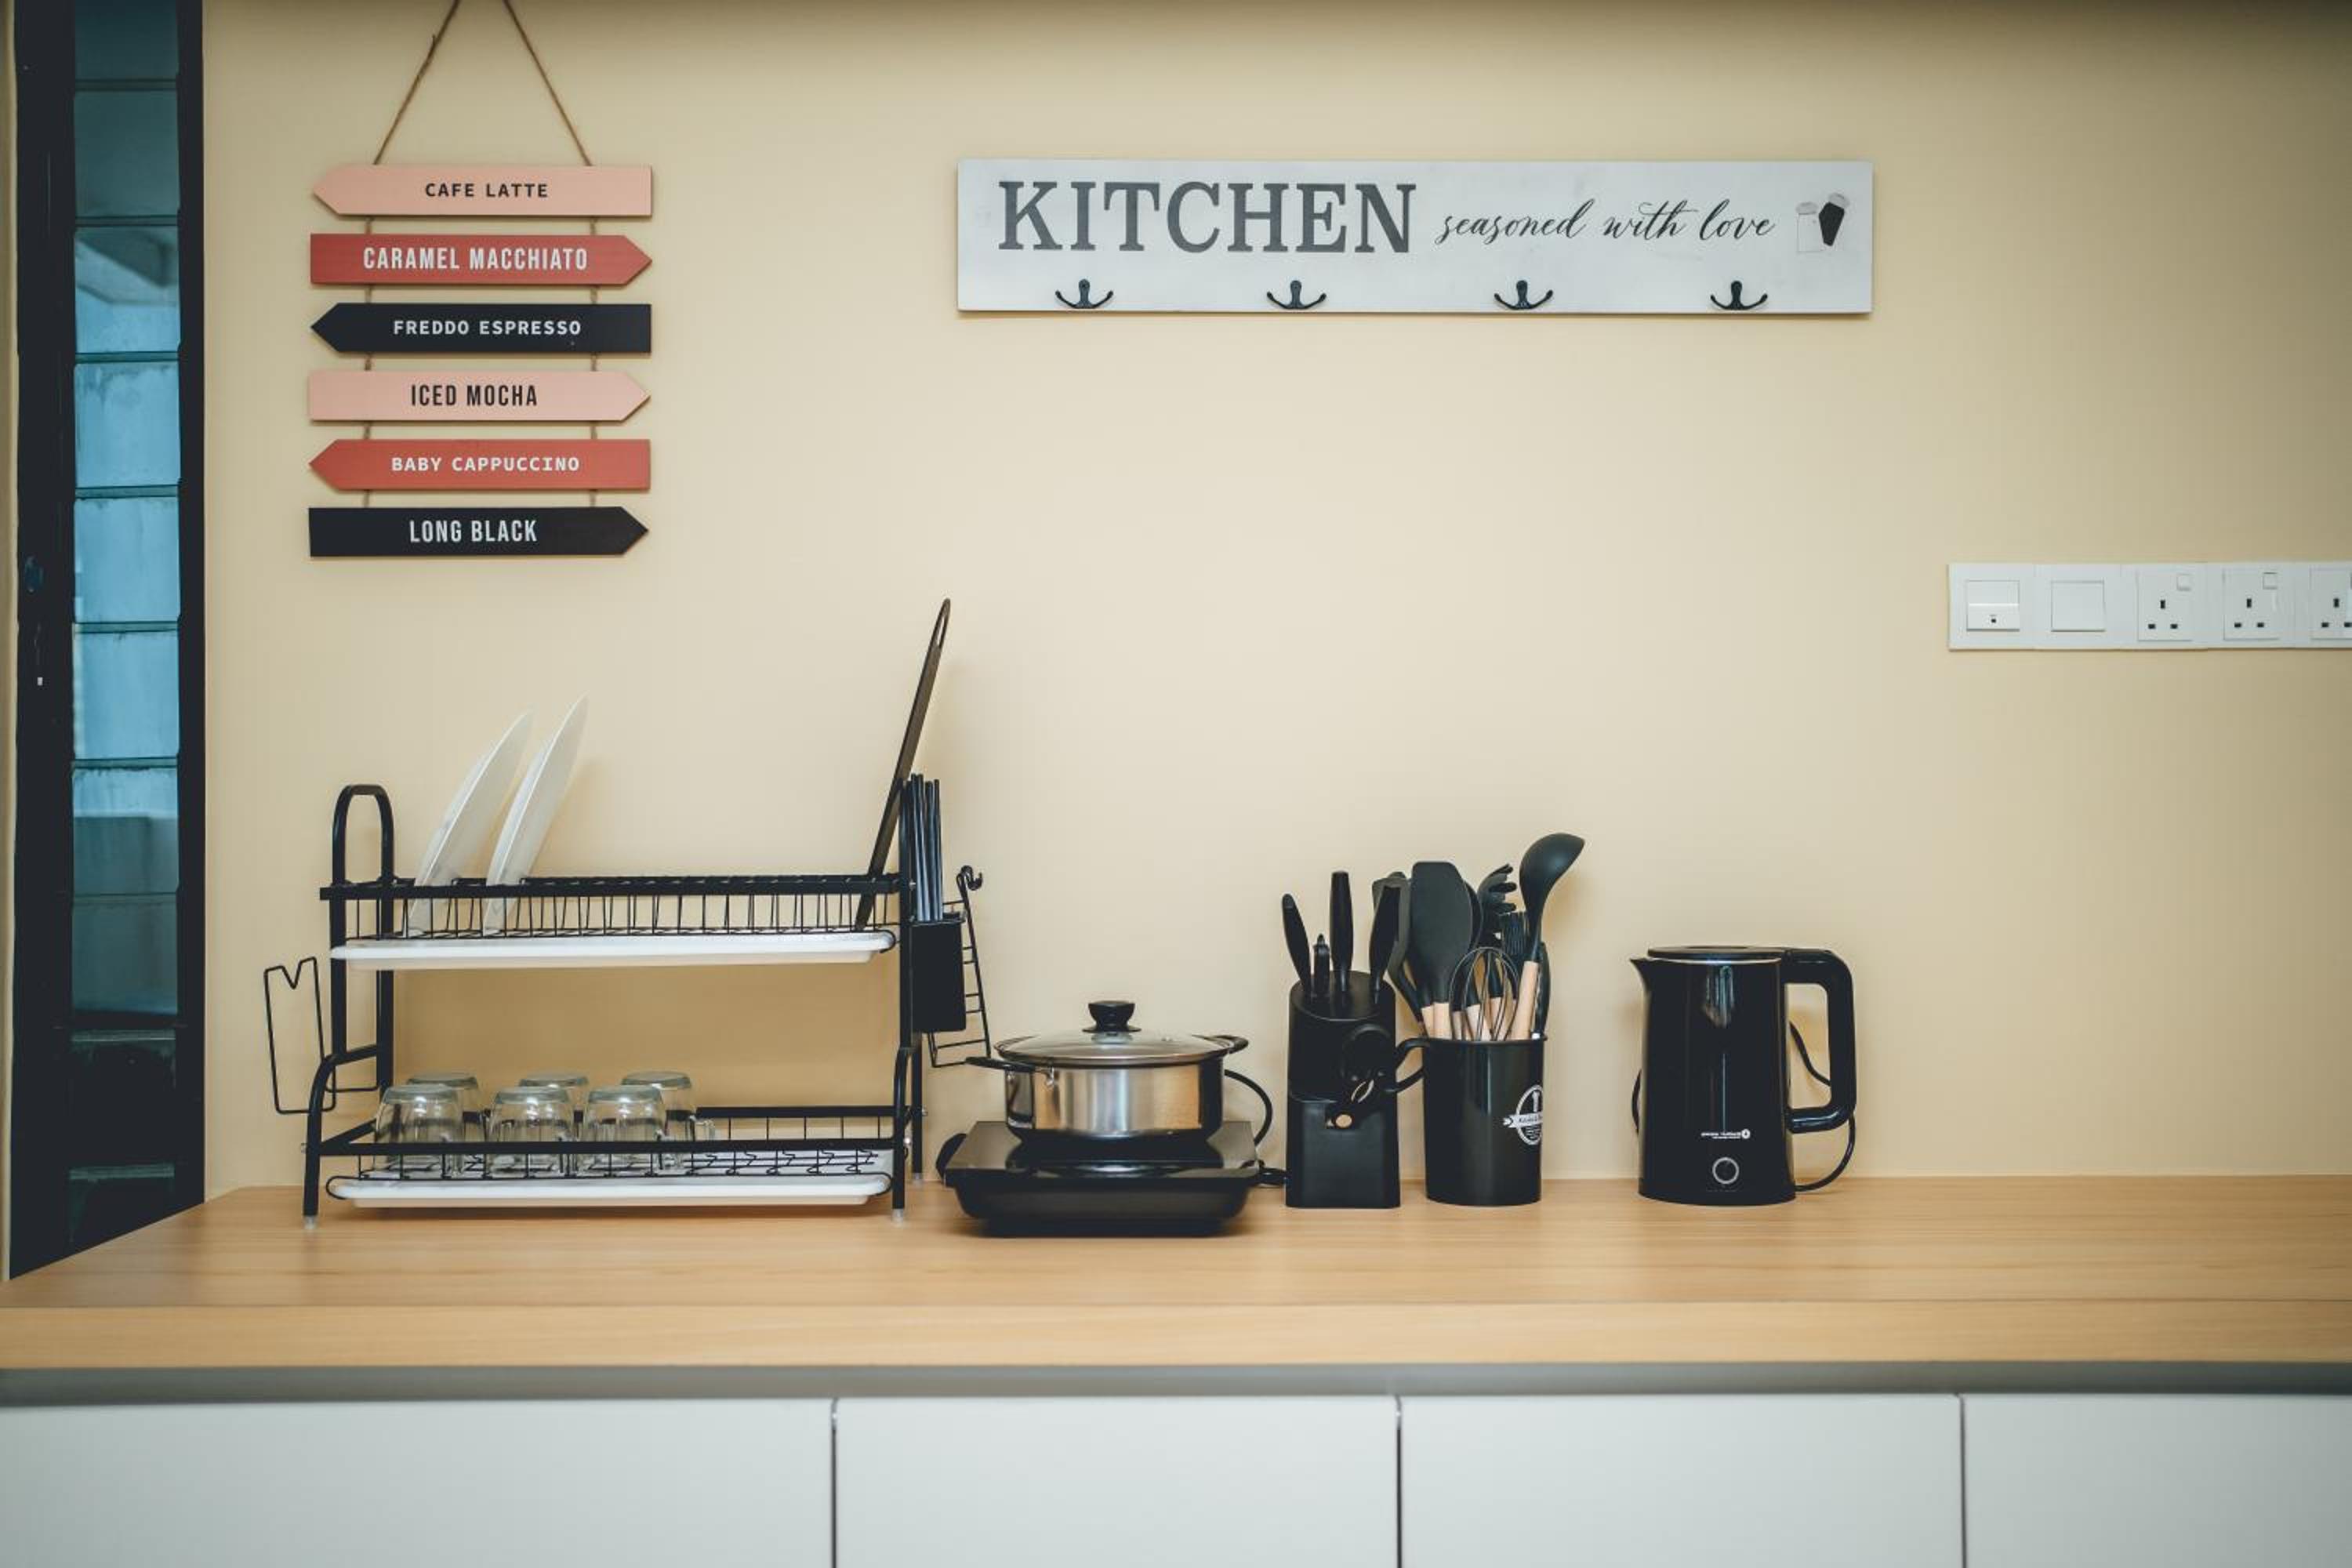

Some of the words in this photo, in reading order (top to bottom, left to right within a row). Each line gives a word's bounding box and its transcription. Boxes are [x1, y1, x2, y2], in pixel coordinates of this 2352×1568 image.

[425, 183, 474, 198] CAFE
[485, 183, 548, 198] LATTE
[998, 180, 1417, 253] KITCHEN
[1435, 198, 1595, 246] seasoned
[1602, 200, 1694, 241] with
[1698, 198, 1777, 241] love
[363, 247, 460, 270] CARAMEL
[470, 247, 587, 270] MACCHIATO
[394, 320, 470, 335] FREDDO
[479, 320, 581, 336] ESPRESSO
[411, 384, 457, 407] ICED
[466, 384, 537, 407] MOCHA
[391, 457, 442, 471] BABY
[452, 456, 579, 471] CAPPUCCINO
[409, 520, 462, 543] LONG
[471, 520, 537, 543] BLACK
